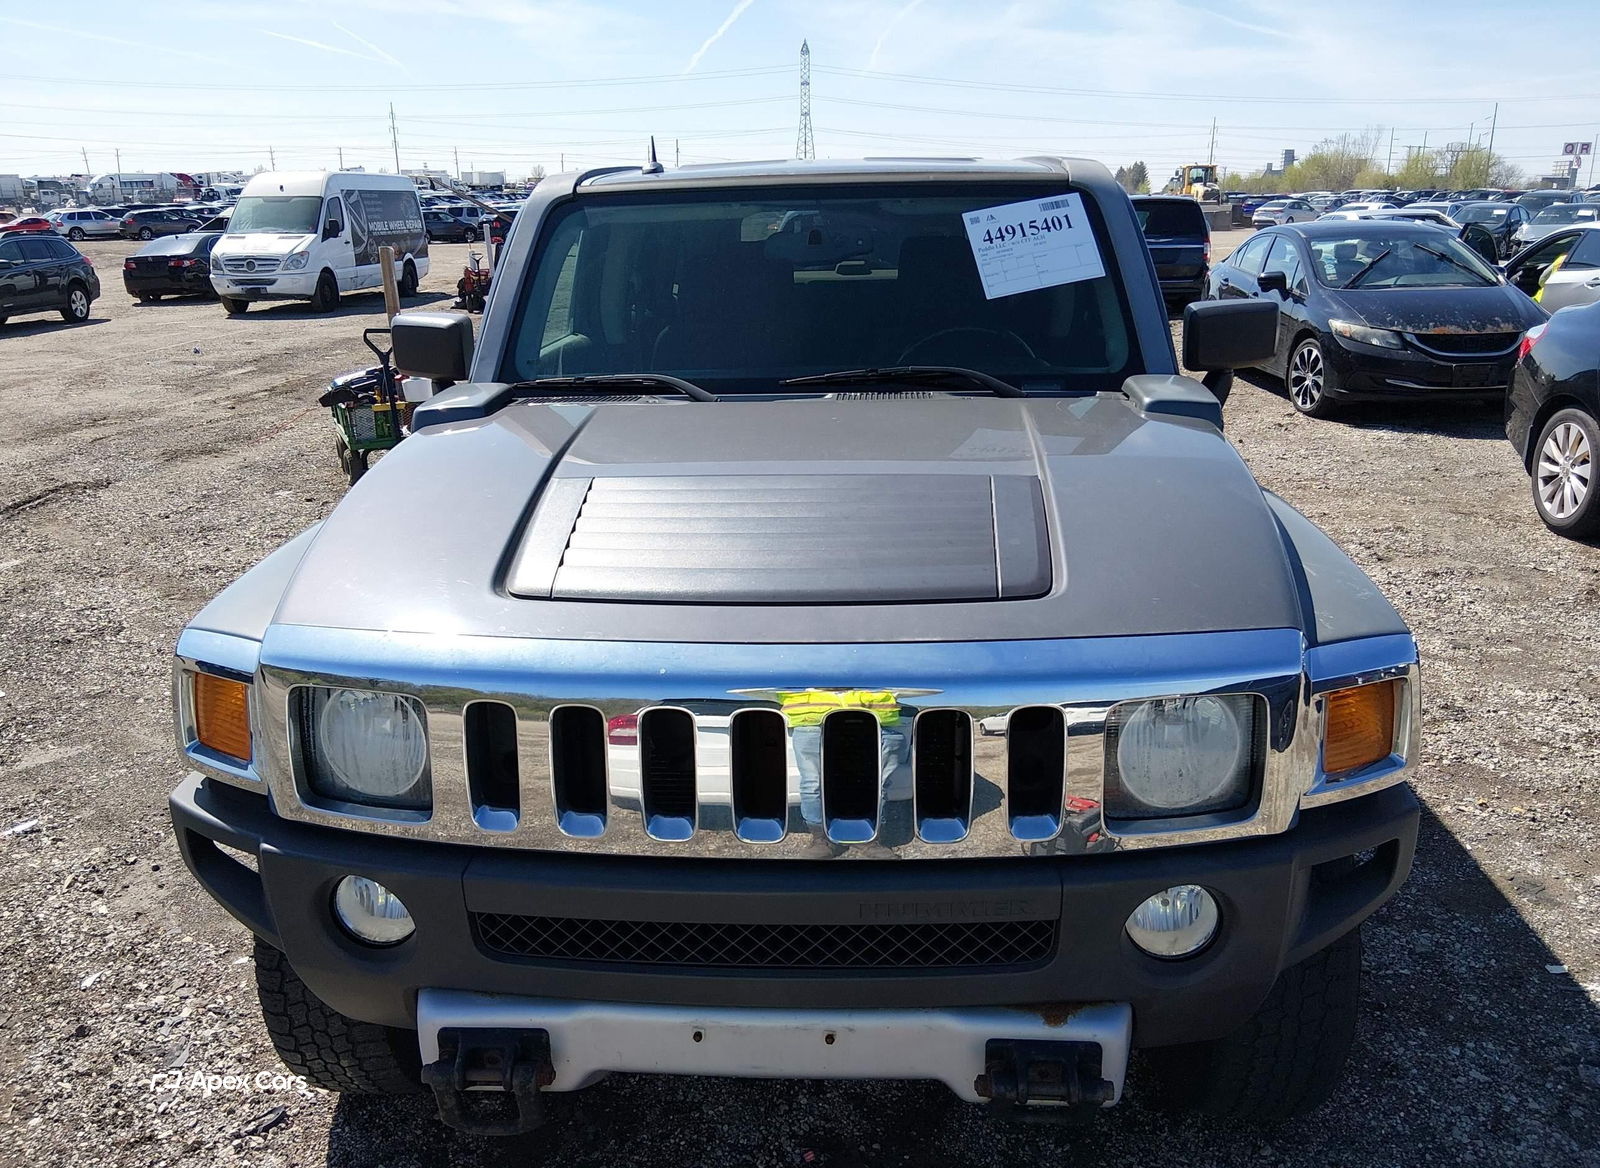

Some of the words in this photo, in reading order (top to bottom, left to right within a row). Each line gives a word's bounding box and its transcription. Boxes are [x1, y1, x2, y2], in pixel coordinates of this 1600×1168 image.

[1565, 143, 1574, 154] Q
[1581, 143, 1590, 153] R
[368, 220, 389, 231] MOBILE
[388, 220, 406, 230] WHEEL
[406, 219, 422, 229] REPAIR
[982, 213, 1075, 245] 44915401
[859, 900, 1036, 919] HUMMER
